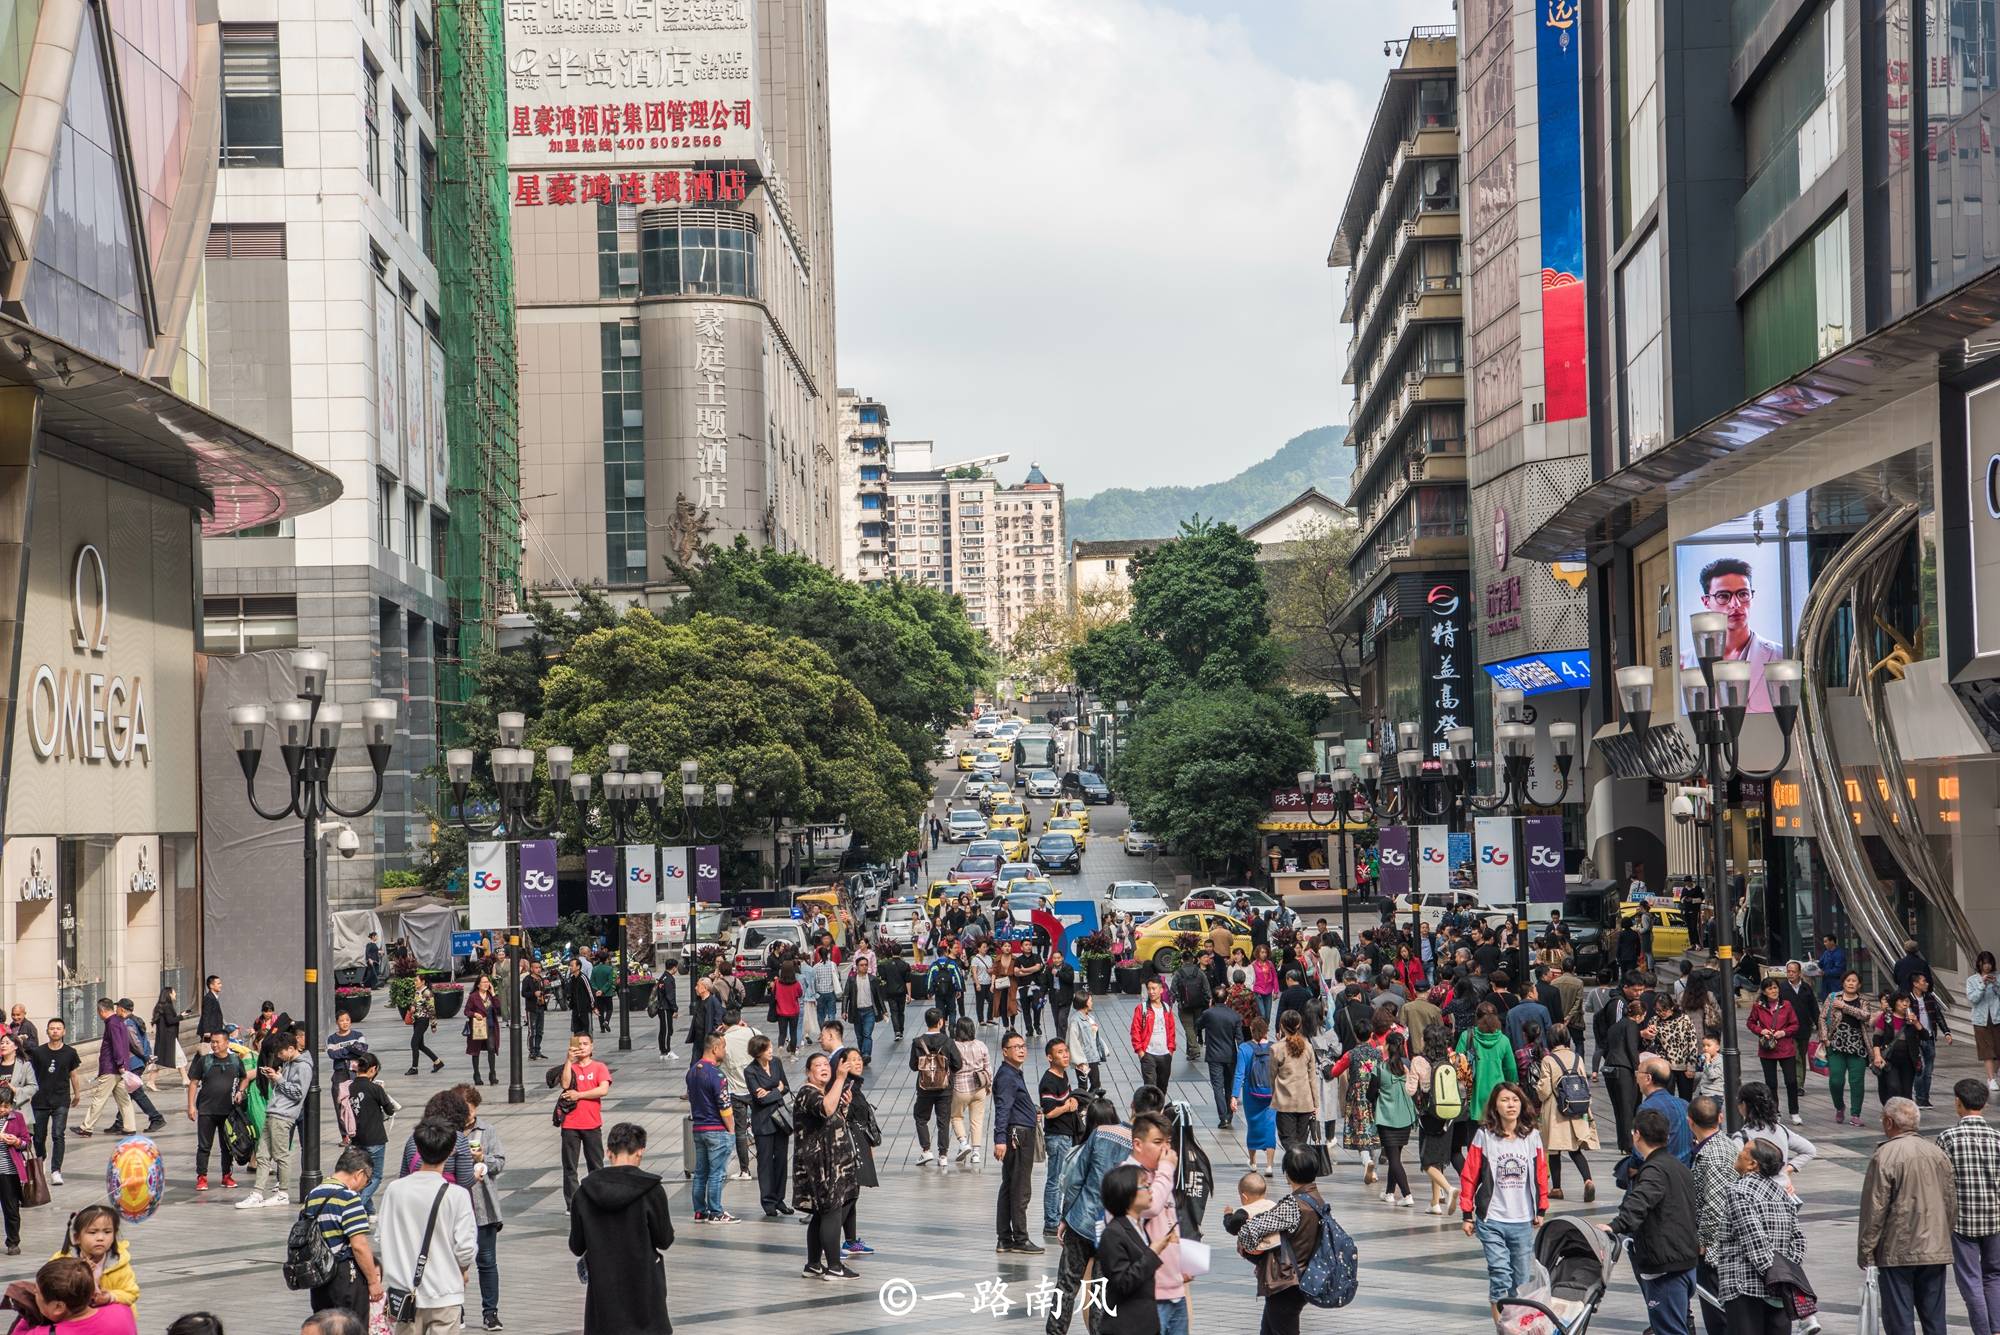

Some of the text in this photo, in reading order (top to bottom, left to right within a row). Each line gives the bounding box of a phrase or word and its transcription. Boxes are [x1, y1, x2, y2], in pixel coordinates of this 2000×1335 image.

[522, 24, 542, 34] TEL
[546, 47, 691, 88] 半岛酒店
[692, 65, 749, 80] 68575555
[511, 99, 751, 137] 星豪鸿酒店集团管理公司
[548, 138, 613, 153] 加盟热线
[617, 136, 646, 151] 400
[514, 168, 747, 207] 星豪鸿连锁酒店
[693, 304, 728, 509] 豪庭主题酒店
[27, 663, 152, 765] OMEGA
[1381, 848, 1406, 866] 5G
[1422, 847, 1445, 864] 5G
[1481, 845, 1509, 866] 5G
[1530, 845, 1561, 868] 5G
[473, 871, 502, 892] 5G
[523, 869, 555, 892] 5G
[589, 869, 613, 887] 5G
[630, 867, 652, 883] 5G
[666, 865, 685, 878] 5G
[697, 863, 718, 879] 5G
[20, 876, 53, 901] OMEGA
[130, 871, 157, 893] OMEGA
